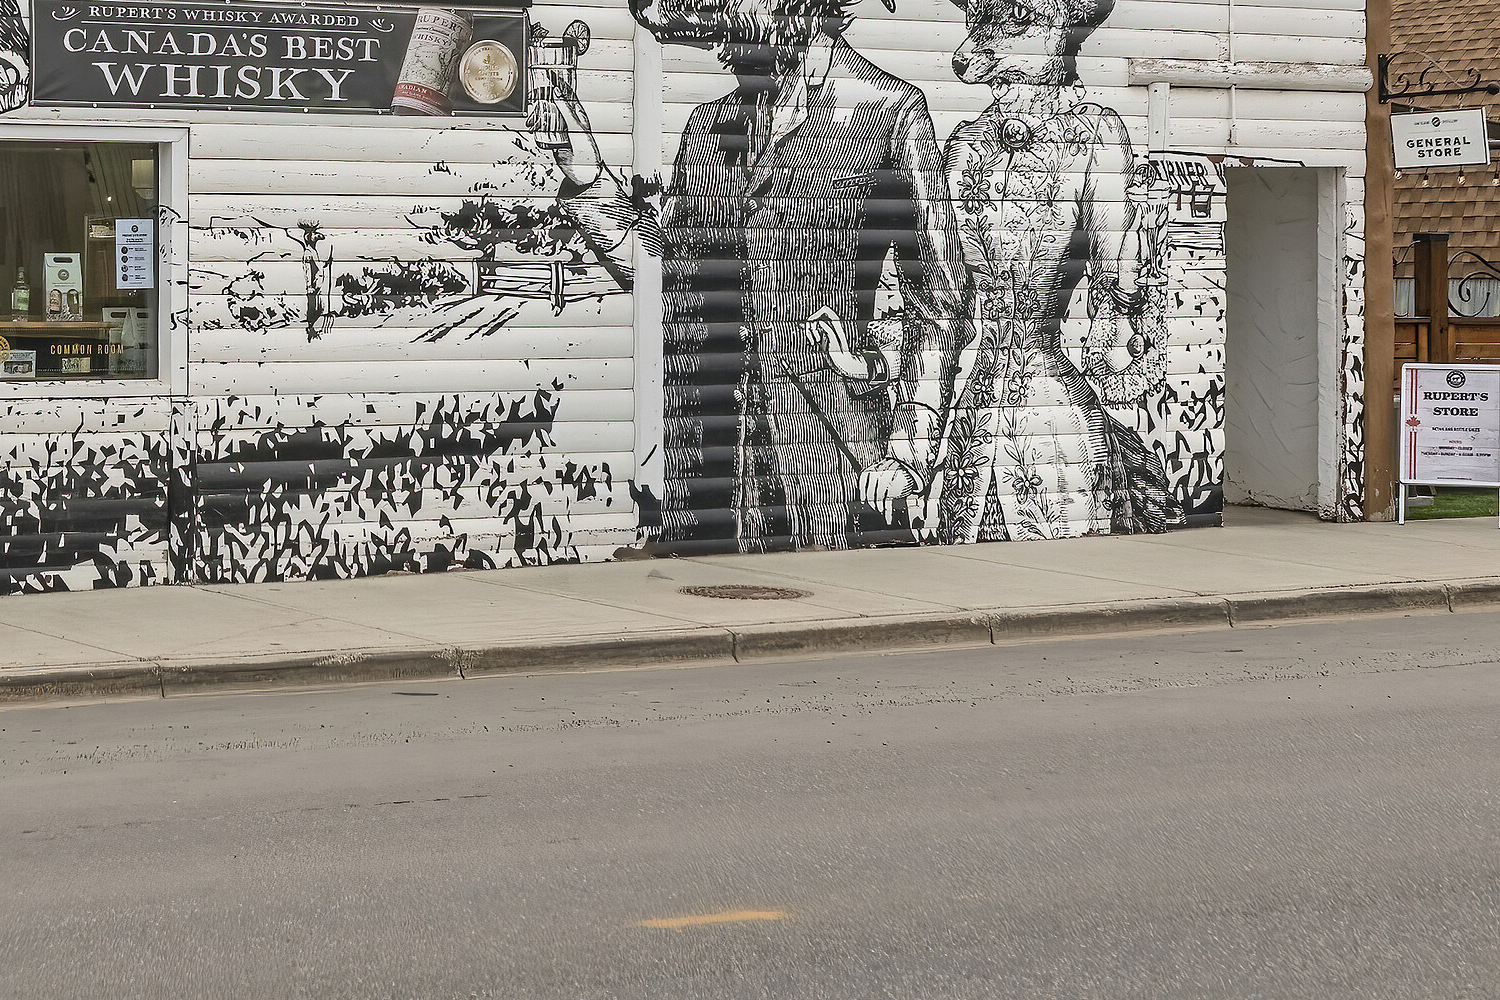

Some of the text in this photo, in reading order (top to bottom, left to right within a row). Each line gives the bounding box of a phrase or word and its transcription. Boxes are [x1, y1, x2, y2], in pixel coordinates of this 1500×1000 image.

[88, 5, 359, 27] RUPERT'S WHISKY AWARDED
[63, 28, 381, 62] CANADA'S BEST
[91, 62, 356, 101] WHISKY
[1406, 136, 1471, 149] GENERAL
[1418, 147, 1462, 158] STORE
[50, 344, 124, 355] COMMON ROOM
[1423, 391, 1489, 402] RUPERT'S
[1433, 407, 1479, 417] STORE
